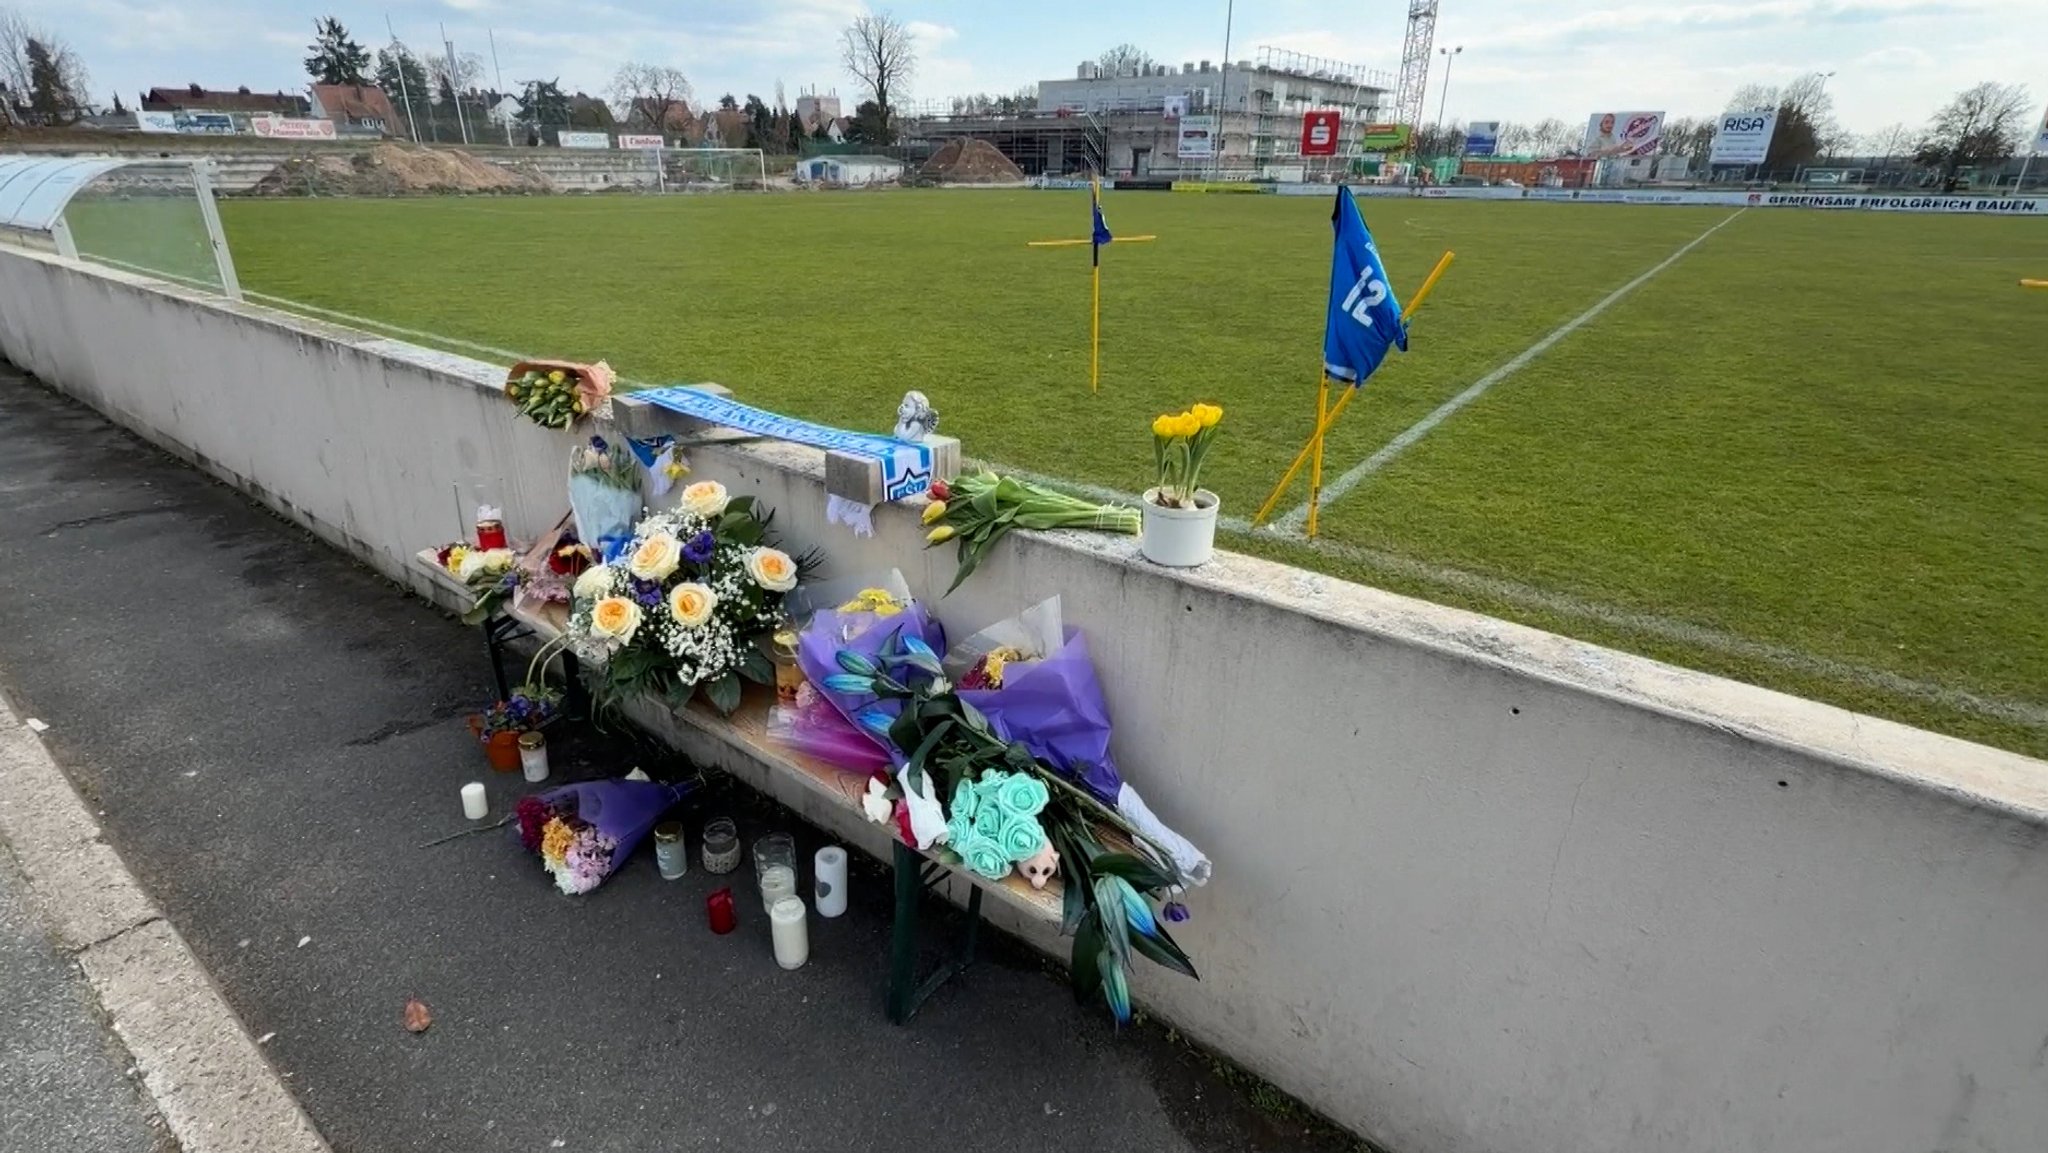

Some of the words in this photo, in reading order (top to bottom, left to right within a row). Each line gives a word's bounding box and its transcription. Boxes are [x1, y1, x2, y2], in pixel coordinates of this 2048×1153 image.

[1723, 117, 1765, 131] RISA
[1769, 195, 1856, 207] GEMEINSAM
[1860, 197, 1971, 211] ERFOLGREICH
[1975, 200, 2039, 212] BAUEN.
[1341, 264, 1387, 328] 12
